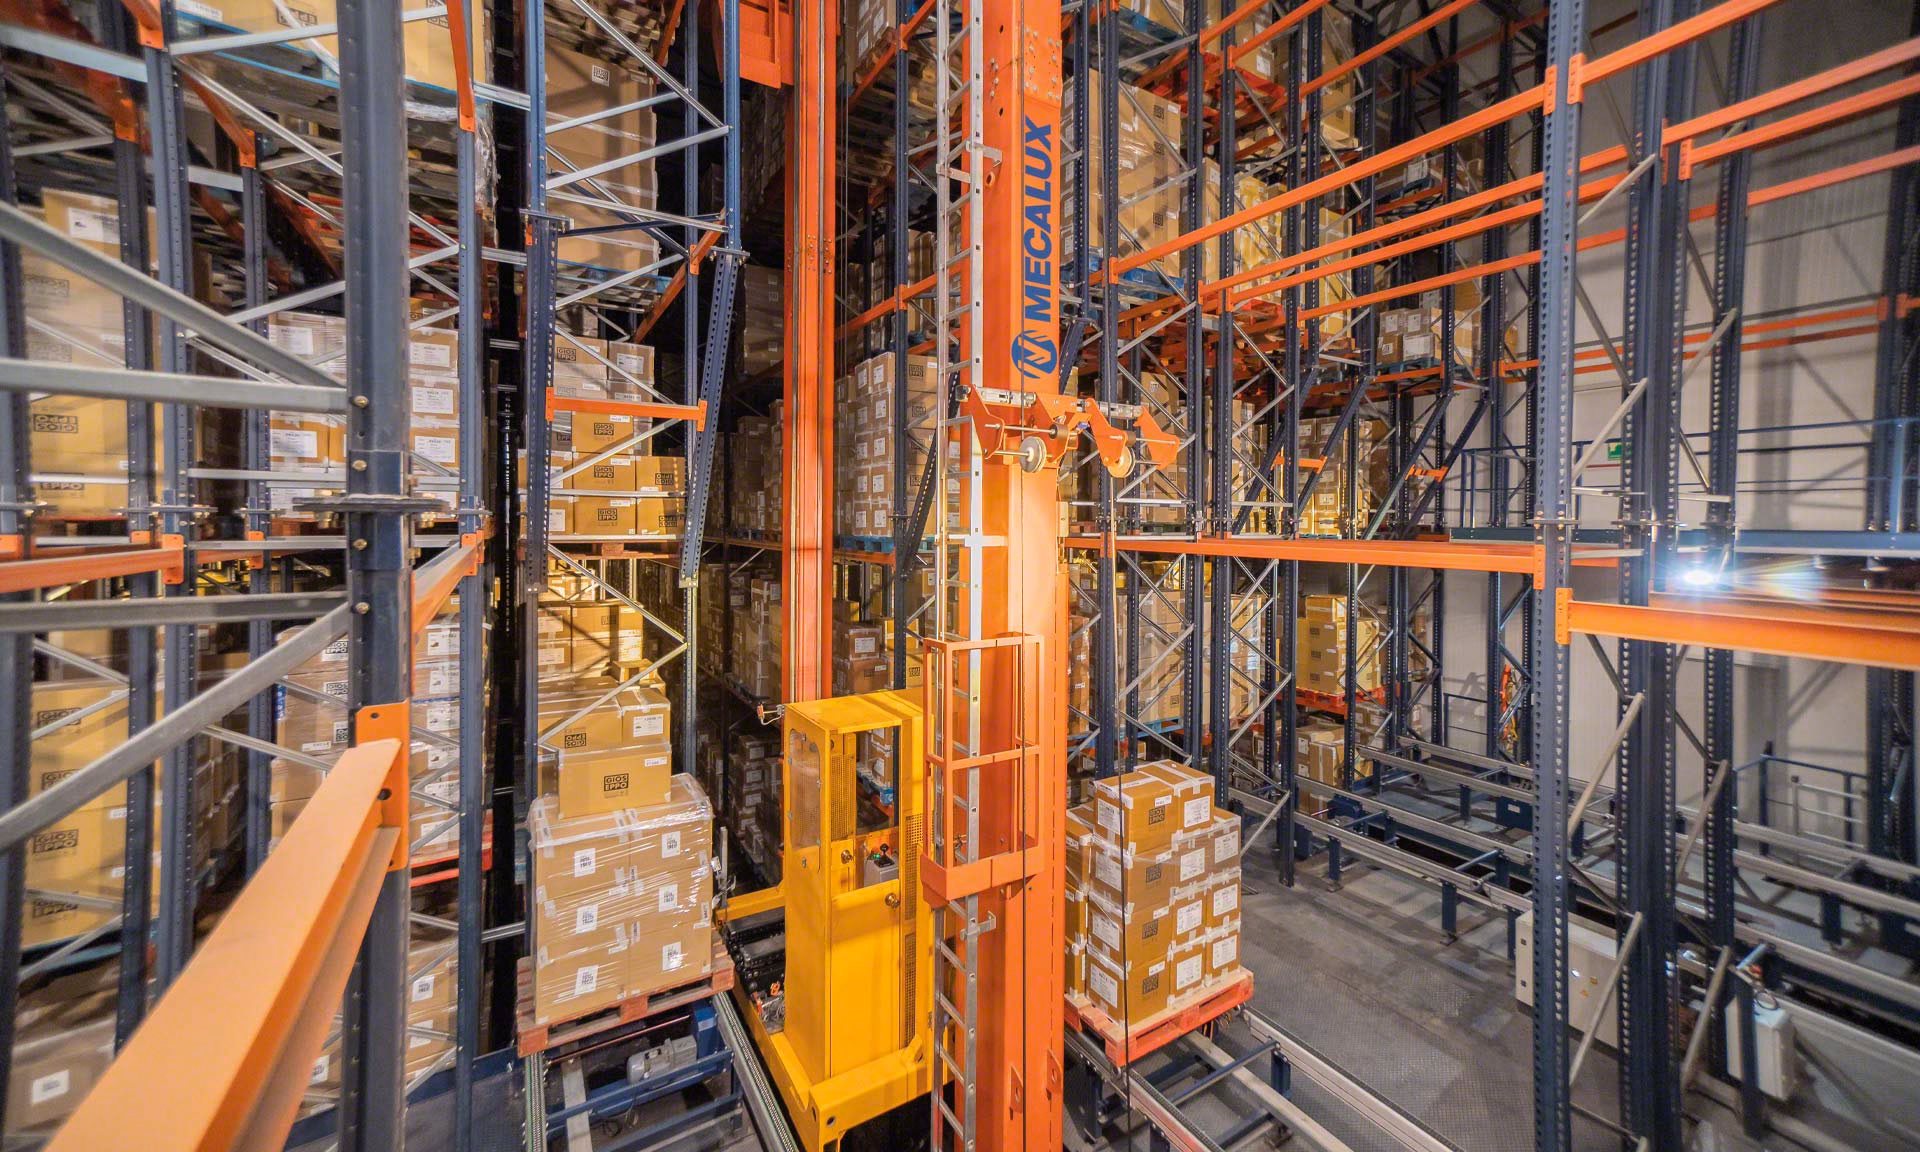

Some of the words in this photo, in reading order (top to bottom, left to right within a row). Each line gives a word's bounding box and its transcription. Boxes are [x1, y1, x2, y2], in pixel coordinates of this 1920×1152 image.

[1023, 115, 1052, 322] MECALUX
[605, 775, 627, 783] GIOS
[605, 781, 627, 790] EPPO
